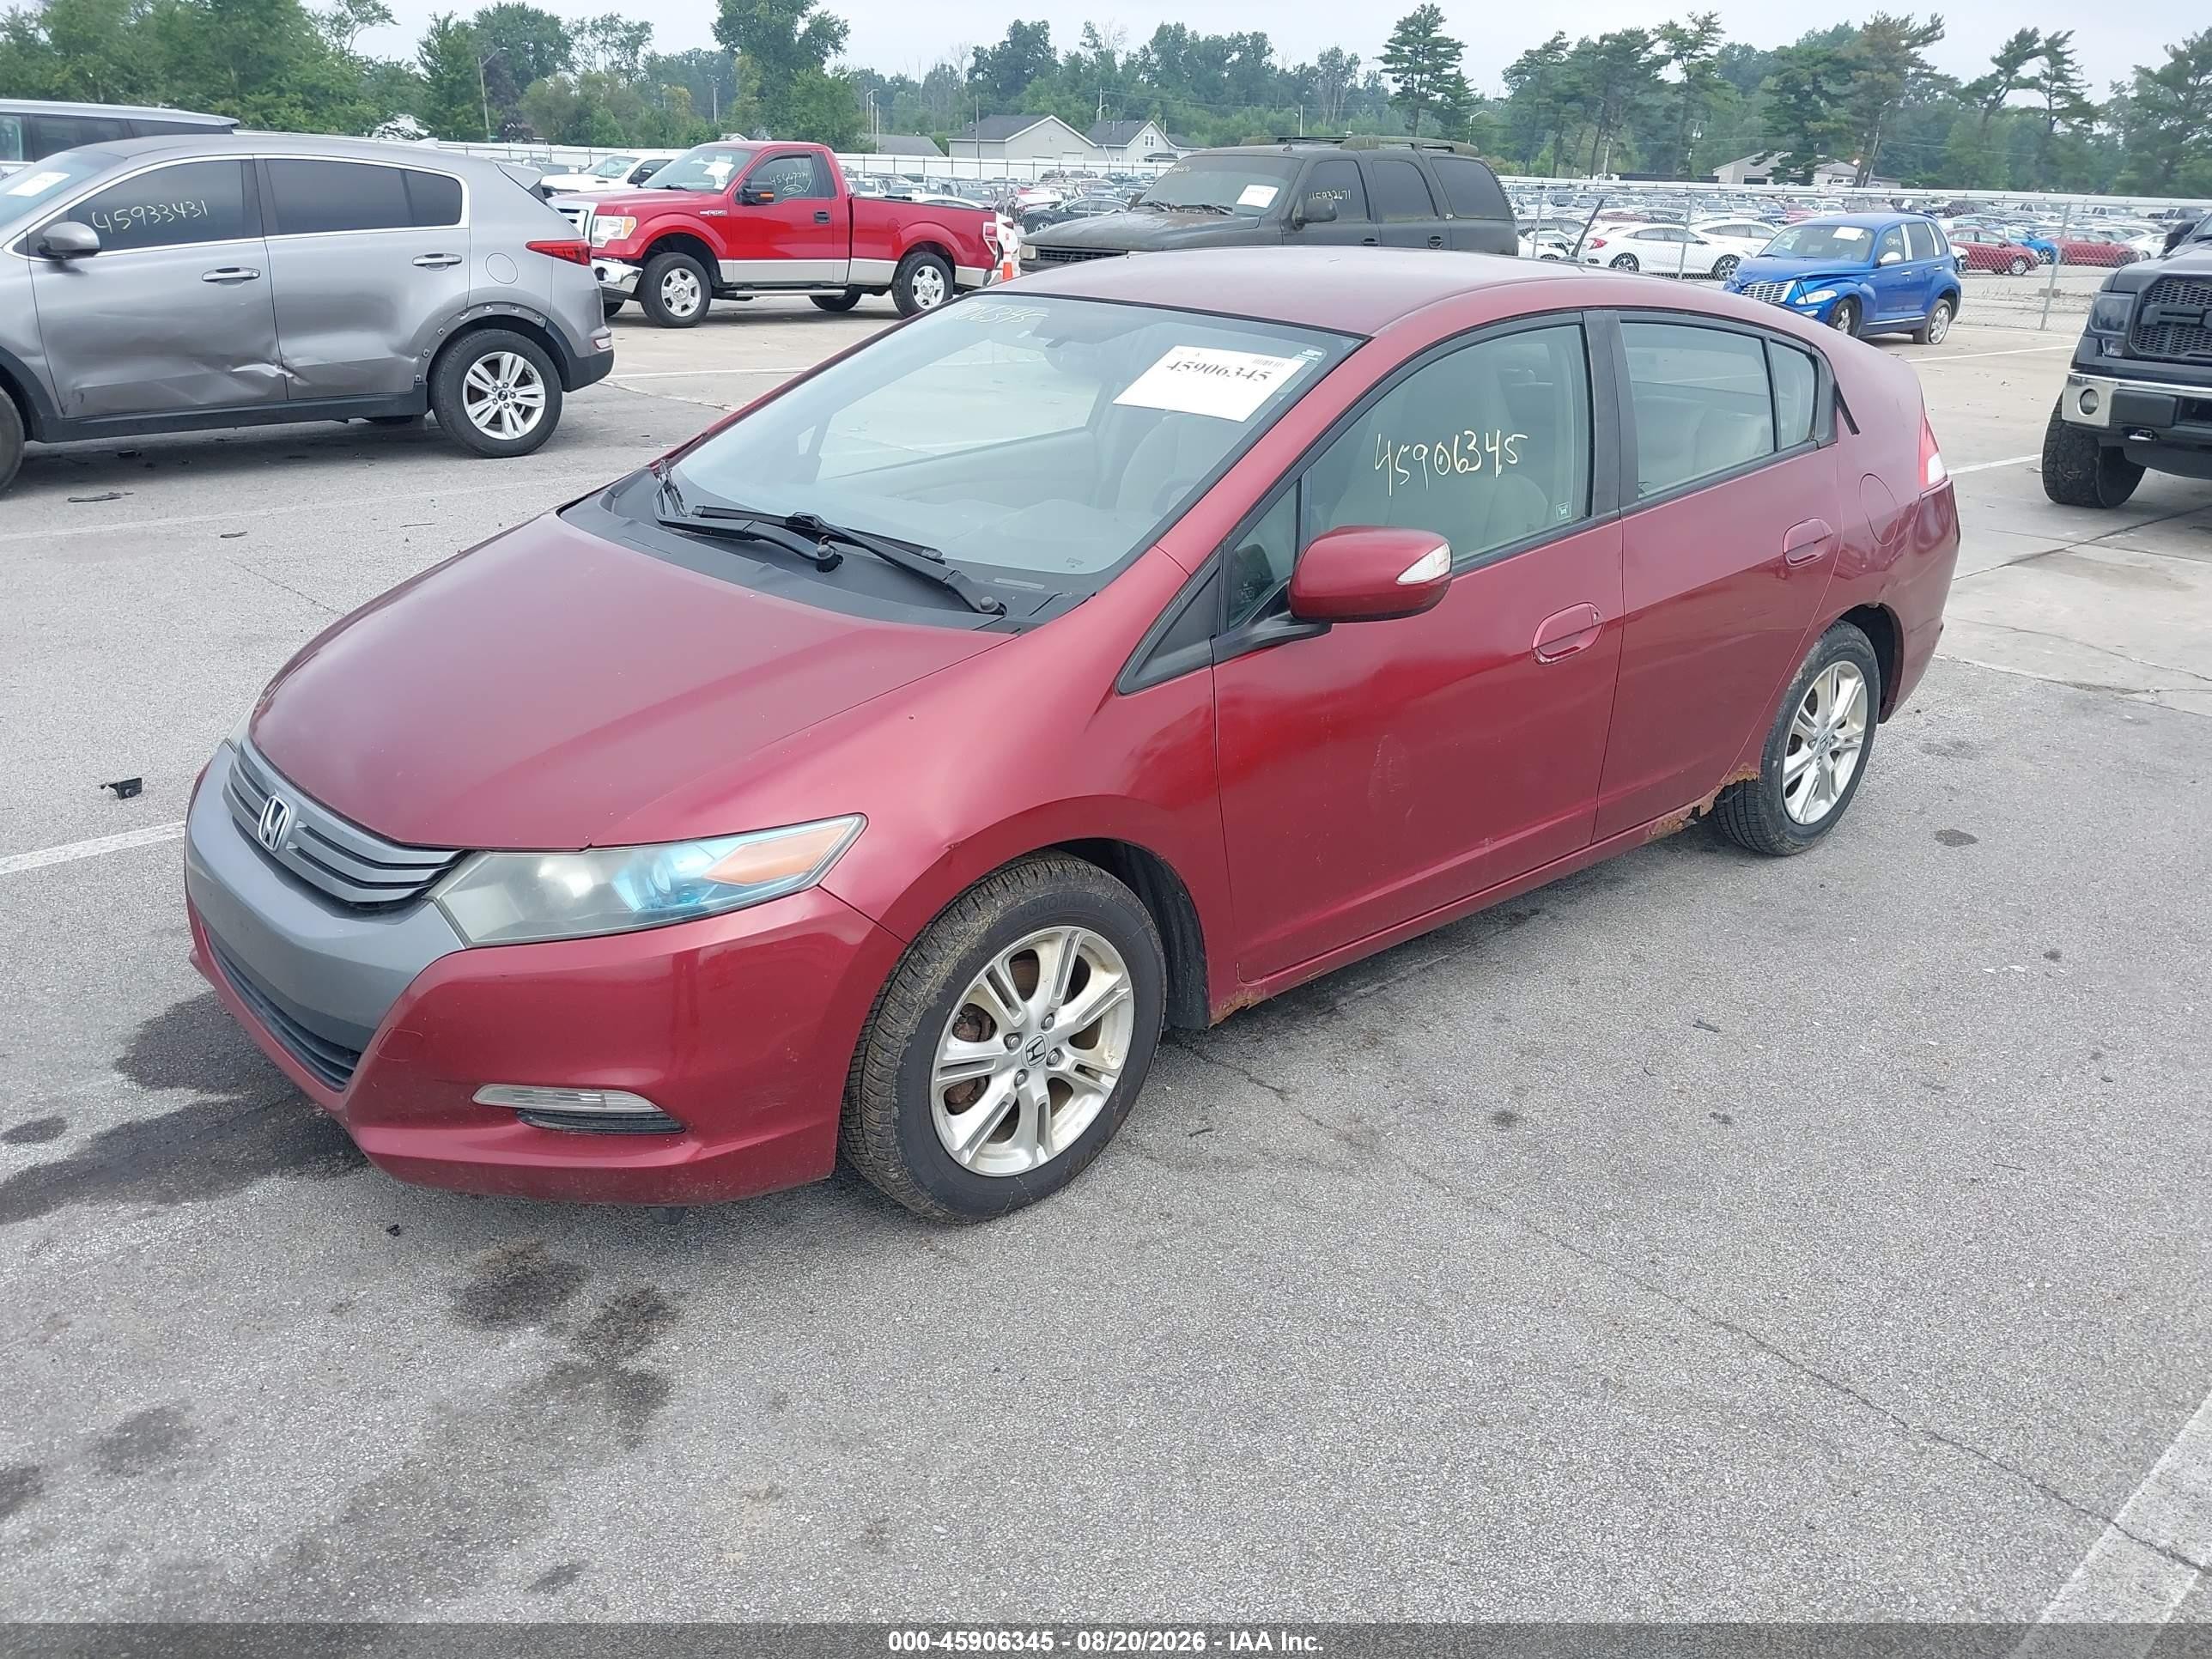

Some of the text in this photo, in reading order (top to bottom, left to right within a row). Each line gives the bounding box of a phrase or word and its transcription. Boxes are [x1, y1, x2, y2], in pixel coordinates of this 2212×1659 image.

[92, 199, 209, 234] 45933431
[1164, 360, 1273, 382] 45906345
[1375, 428, 1529, 497] 45906345
